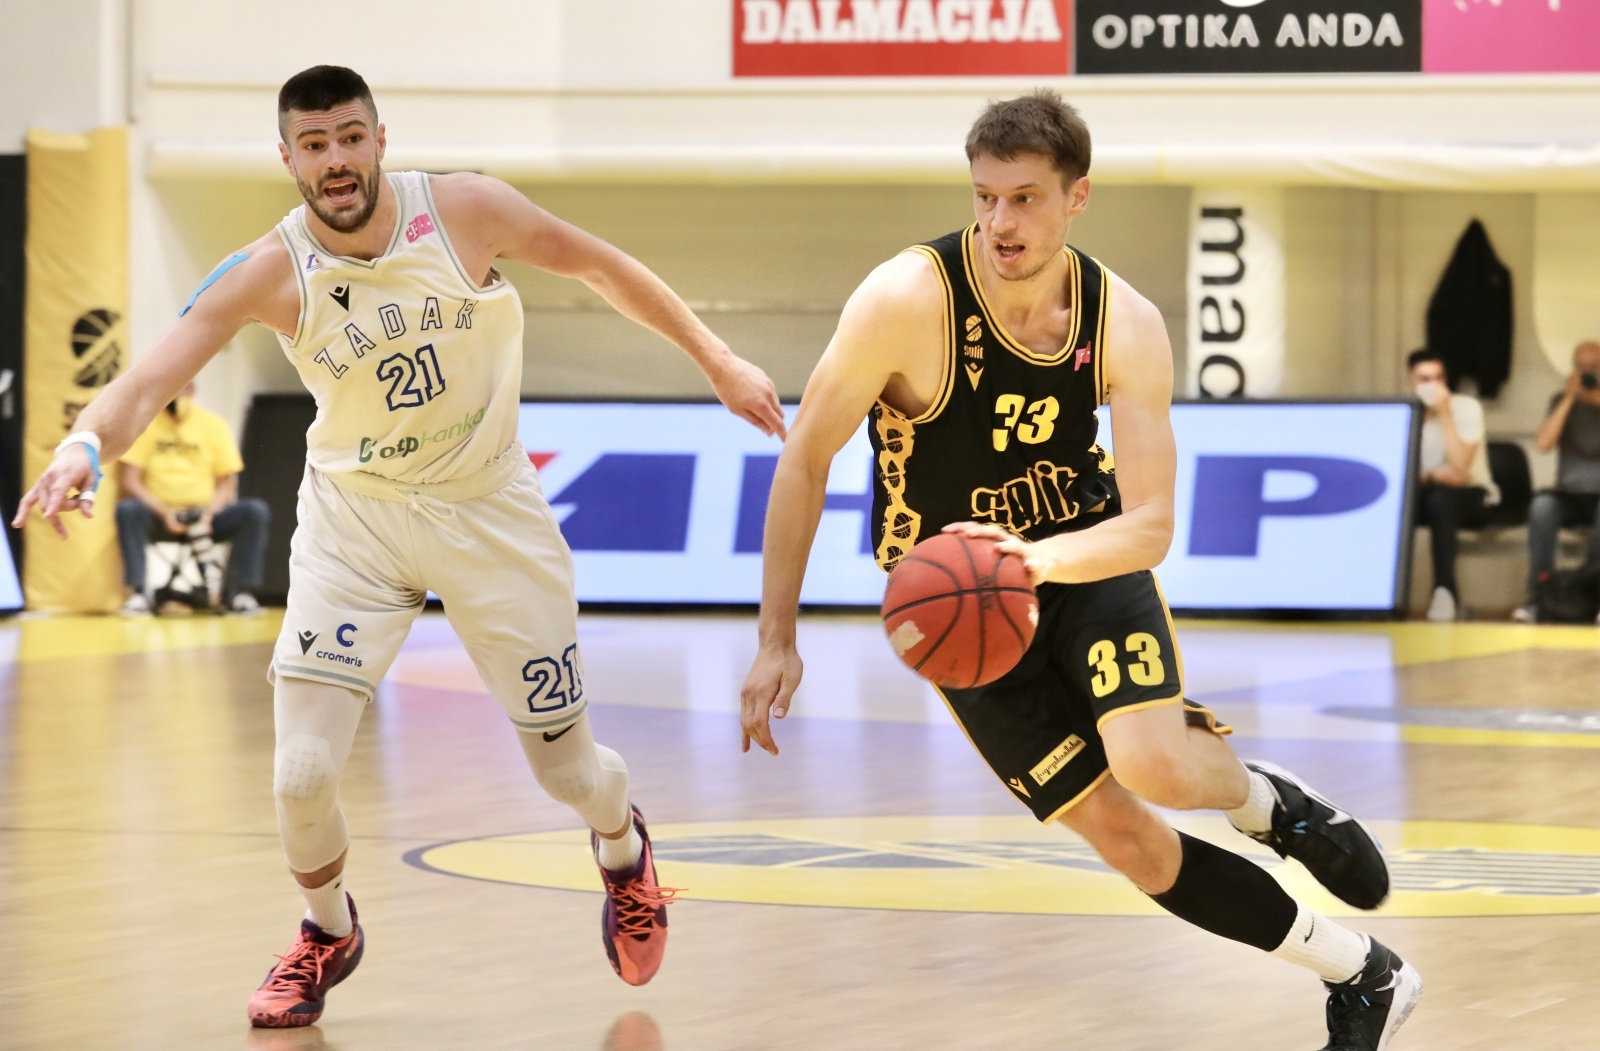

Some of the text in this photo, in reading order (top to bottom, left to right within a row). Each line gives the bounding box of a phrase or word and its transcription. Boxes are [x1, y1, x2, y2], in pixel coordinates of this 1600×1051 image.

[742, 0, 1063, 43] DALMACIJA
[1092, 13, 1404, 49] OPTIKA ANDA
[314, 297, 478, 379] ZADAR
[376, 343, 446, 412] 21
[992, 394, 1060, 452] 33
[316, 650, 362, 667] cromaris
[522, 642, 583, 713] 21
[1088, 632, 1165, 698] 33
